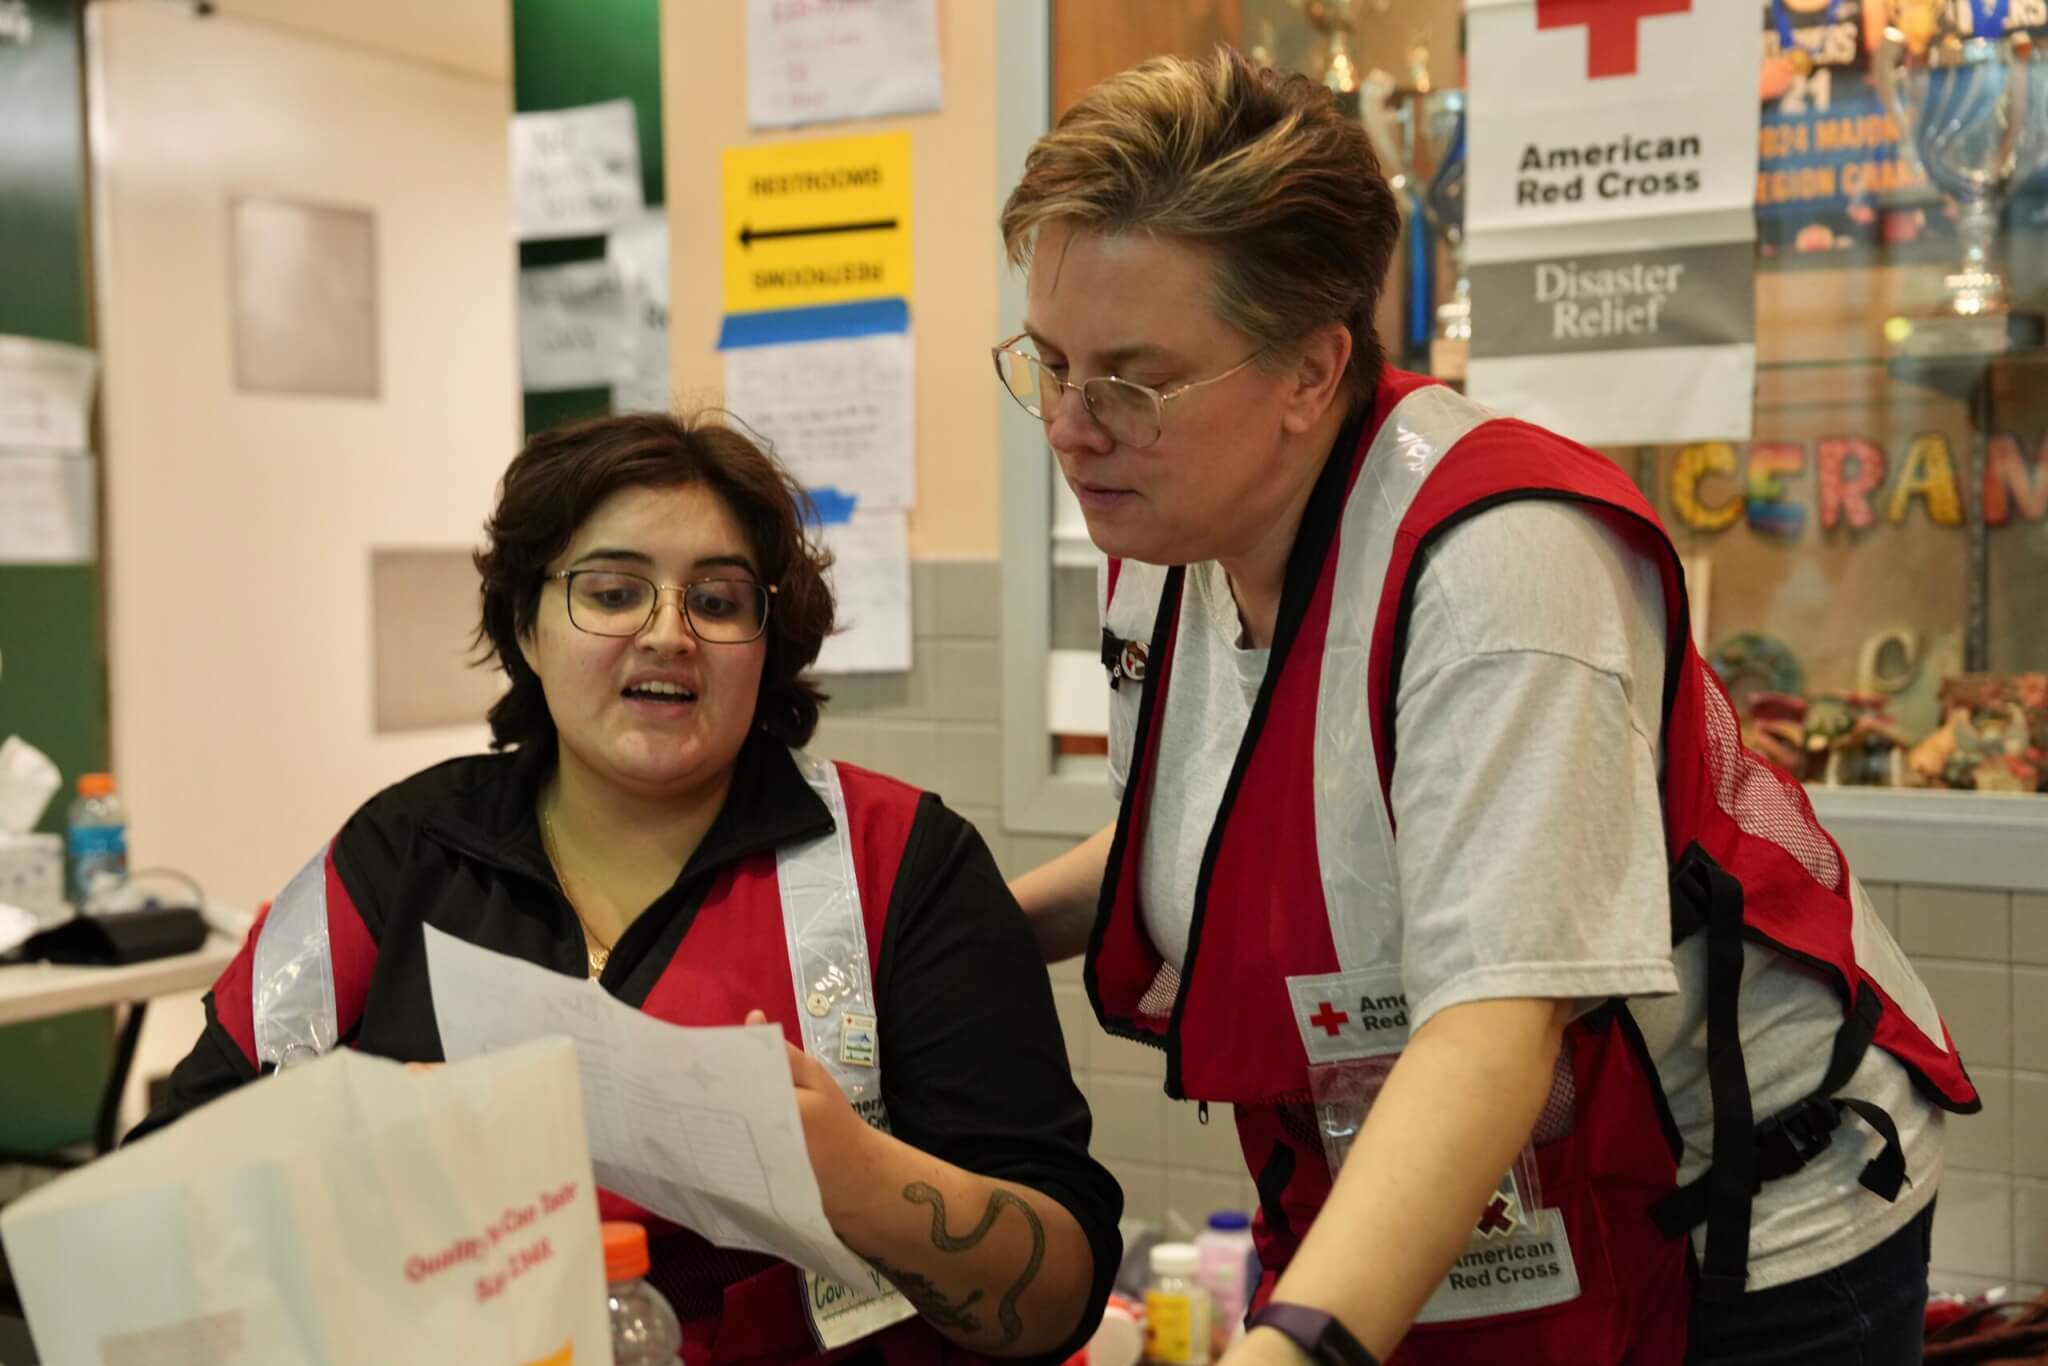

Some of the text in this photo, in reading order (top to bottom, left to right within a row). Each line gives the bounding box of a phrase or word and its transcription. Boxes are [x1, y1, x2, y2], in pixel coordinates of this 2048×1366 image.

[1519, 134, 1701, 171] American
[750, 166, 882, 195] RESTROOMS
[1516, 171, 1701, 206] Red Cross
[1535, 261, 1684, 301] Disaster
[1553, 294, 1666, 339] Relief
[1362, 1011, 1408, 1032] Red
[1455, 1241, 1555, 1269] merican
[1448, 1262, 1560, 1291] Red Cross
